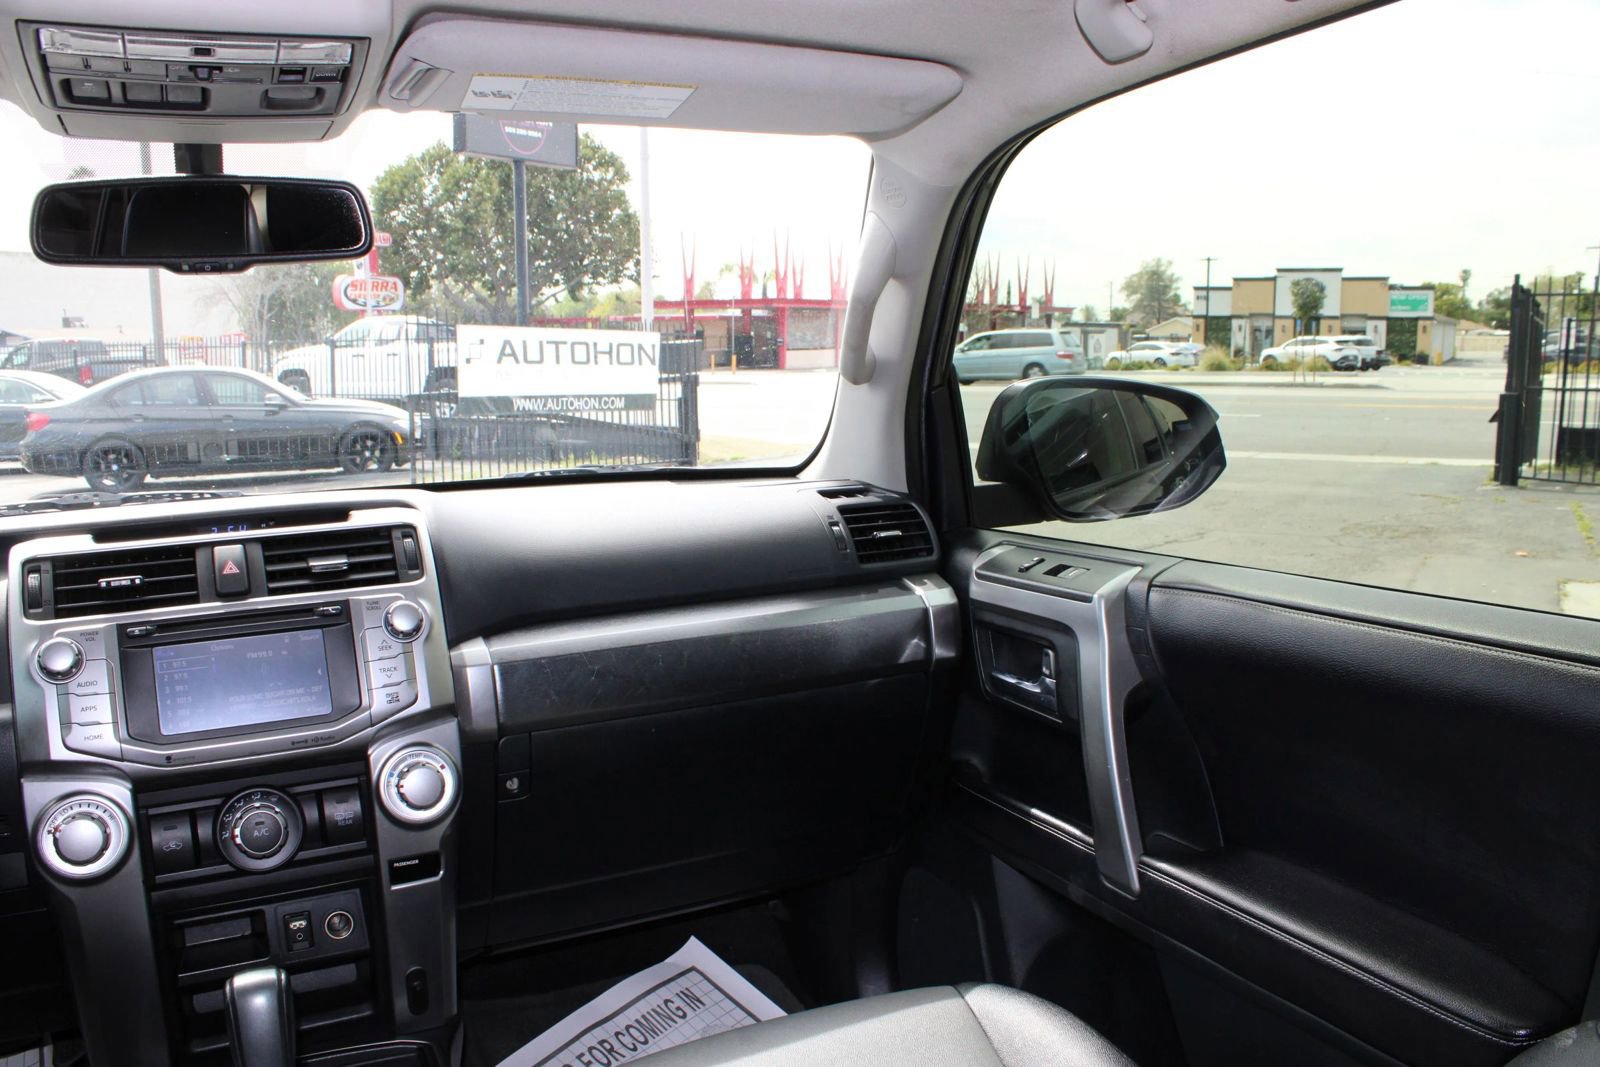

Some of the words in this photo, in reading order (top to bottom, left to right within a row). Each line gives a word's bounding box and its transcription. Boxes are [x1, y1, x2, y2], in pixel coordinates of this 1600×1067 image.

[496, 339, 657, 366] AUTOHON
[512, 397, 625, 411] WWW.AUTOHON.COM
[77, 680, 98, 688] AUDIO
[80, 705, 98, 713] APPS
[253, 827, 269, 837] A/C
[393, 859, 419, 868] PASSENGER
[575, 1038, 625, 1067] FOR
[614, 998, 688, 1053] COMING
[675, 987, 706, 1013] IN
